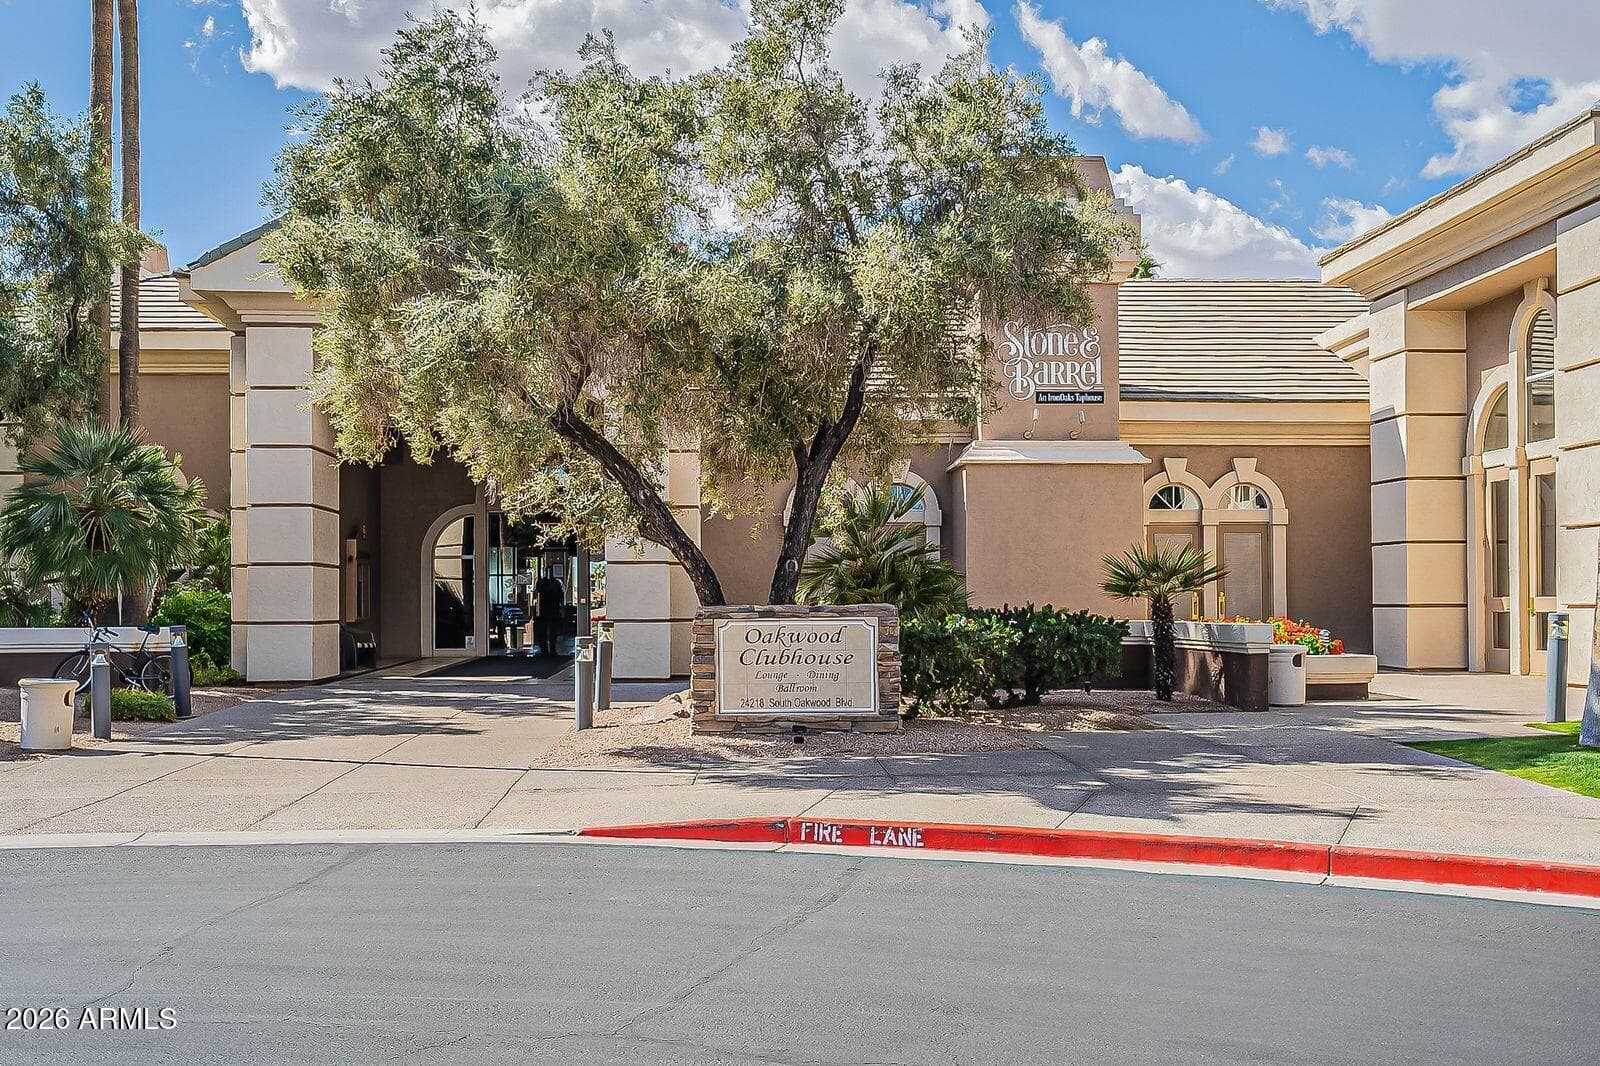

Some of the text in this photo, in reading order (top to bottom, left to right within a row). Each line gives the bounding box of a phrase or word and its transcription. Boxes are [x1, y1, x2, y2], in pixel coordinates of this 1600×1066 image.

[998, 321, 1079, 365] Stone
[1038, 393, 1047, 402] An
[1075, 393, 1103, 404] Taphouse
[745, 625, 848, 648] Oakwood
[739, 648, 854, 666] Clubhouse
[754, 670, 840, 682] Lounge Dining
[775, 682, 818, 693] Ballroom
[740, 697, 765, 708] 24218
[769, 697, 792, 708] South
[794, 697, 831, 708] Oakwood
[800, 821, 925, 847] FIRE LANE
